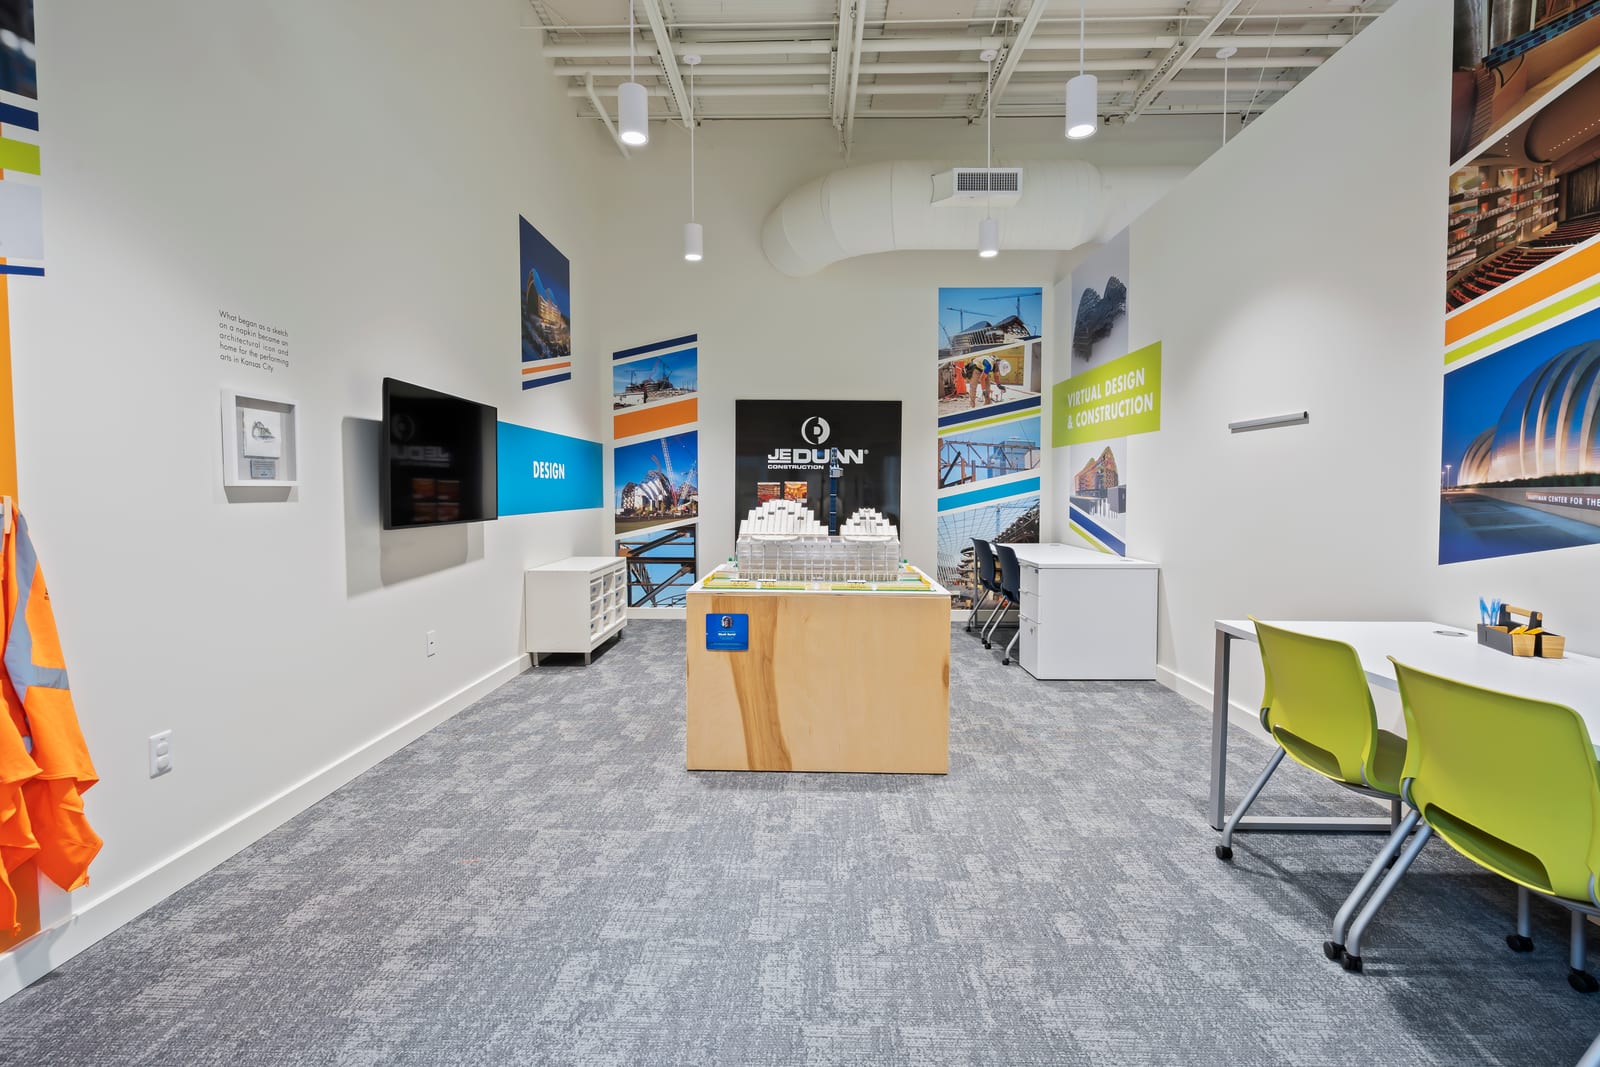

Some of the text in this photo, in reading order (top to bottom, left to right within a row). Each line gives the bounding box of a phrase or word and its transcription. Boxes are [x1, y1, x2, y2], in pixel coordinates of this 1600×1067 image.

[219, 309, 237, 321] What
[238, 315, 258, 328] began
[272, 326, 288, 337] sketch
[220, 333, 288, 356] architectural icon and
[236, 328, 256, 337] napkin
[258, 331, 280, 344] became
[220, 341, 288, 368] home for the performing
[234, 355, 240, 363] in
[240, 356, 261, 368] Kansas
[262, 362, 274, 373] City
[1067, 368, 1145, 408] VIRTUAL DESIGN
[1067, 392, 1153, 430] & CONSTRUCTION
[533, 460, 565, 480] DESIGN
[1548, 495, 1568, 504] CENTER
[1570, 497, 1583, 505] FOR
[1586, 498, 1600, 507] THE
